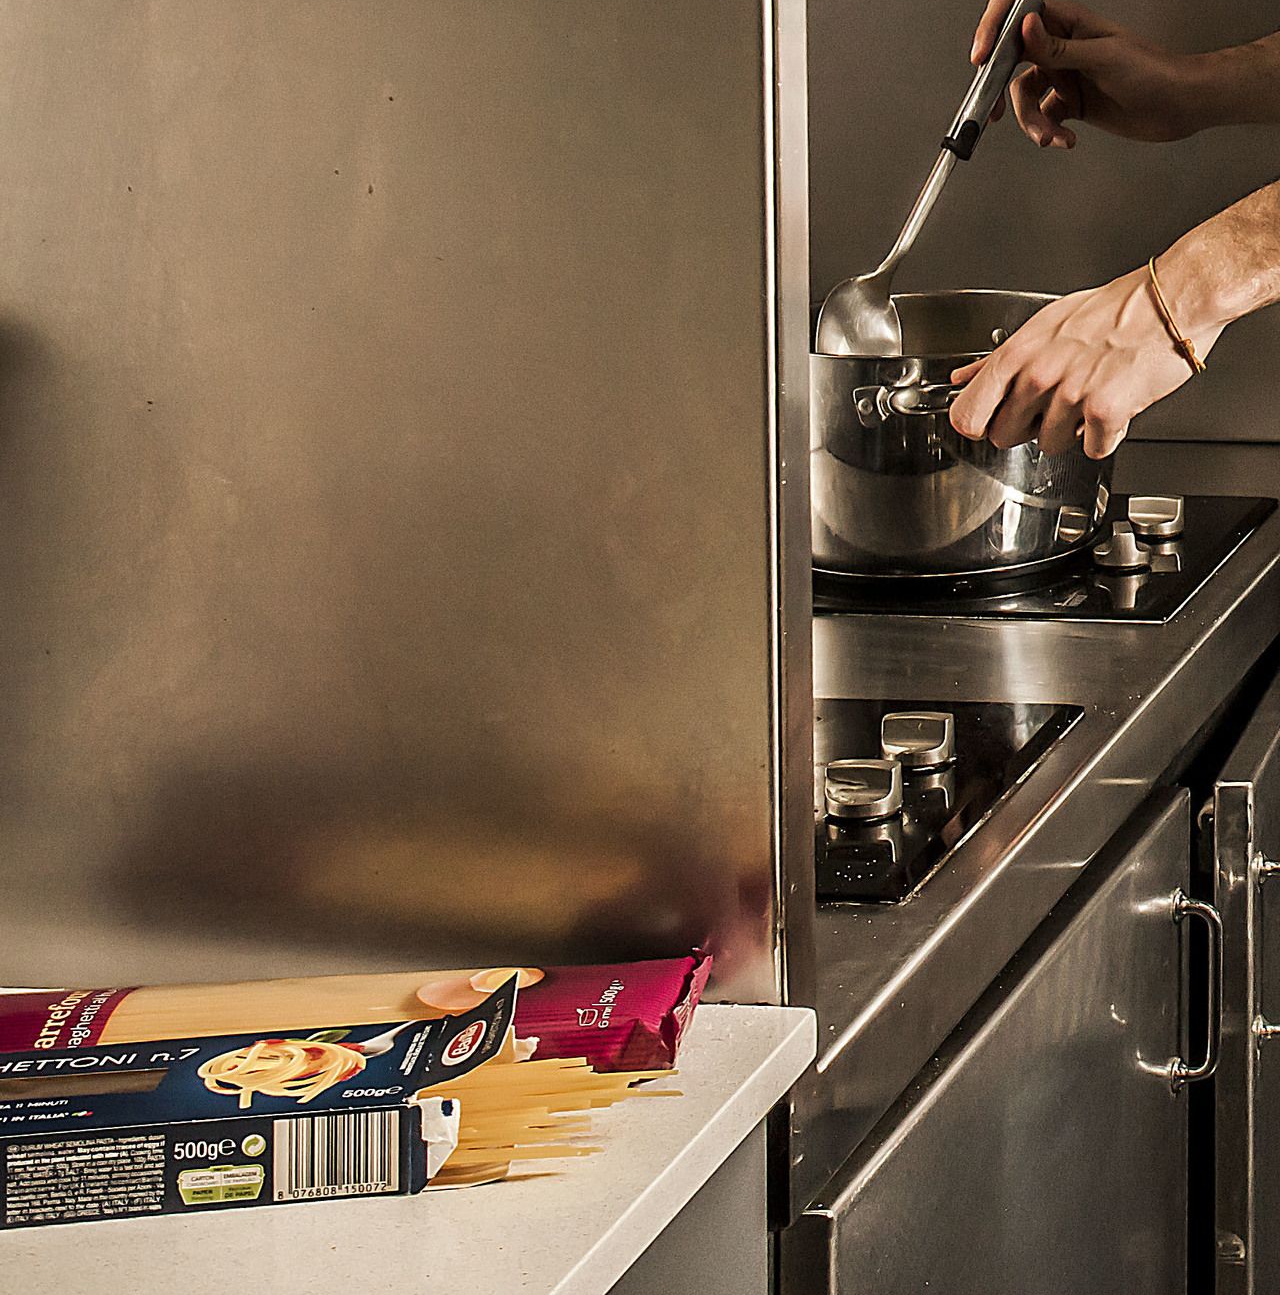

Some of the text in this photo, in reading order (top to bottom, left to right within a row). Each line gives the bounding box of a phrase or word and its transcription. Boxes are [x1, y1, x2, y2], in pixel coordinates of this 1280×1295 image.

[277, 1182, 387, 1200] 8 076808 150072
